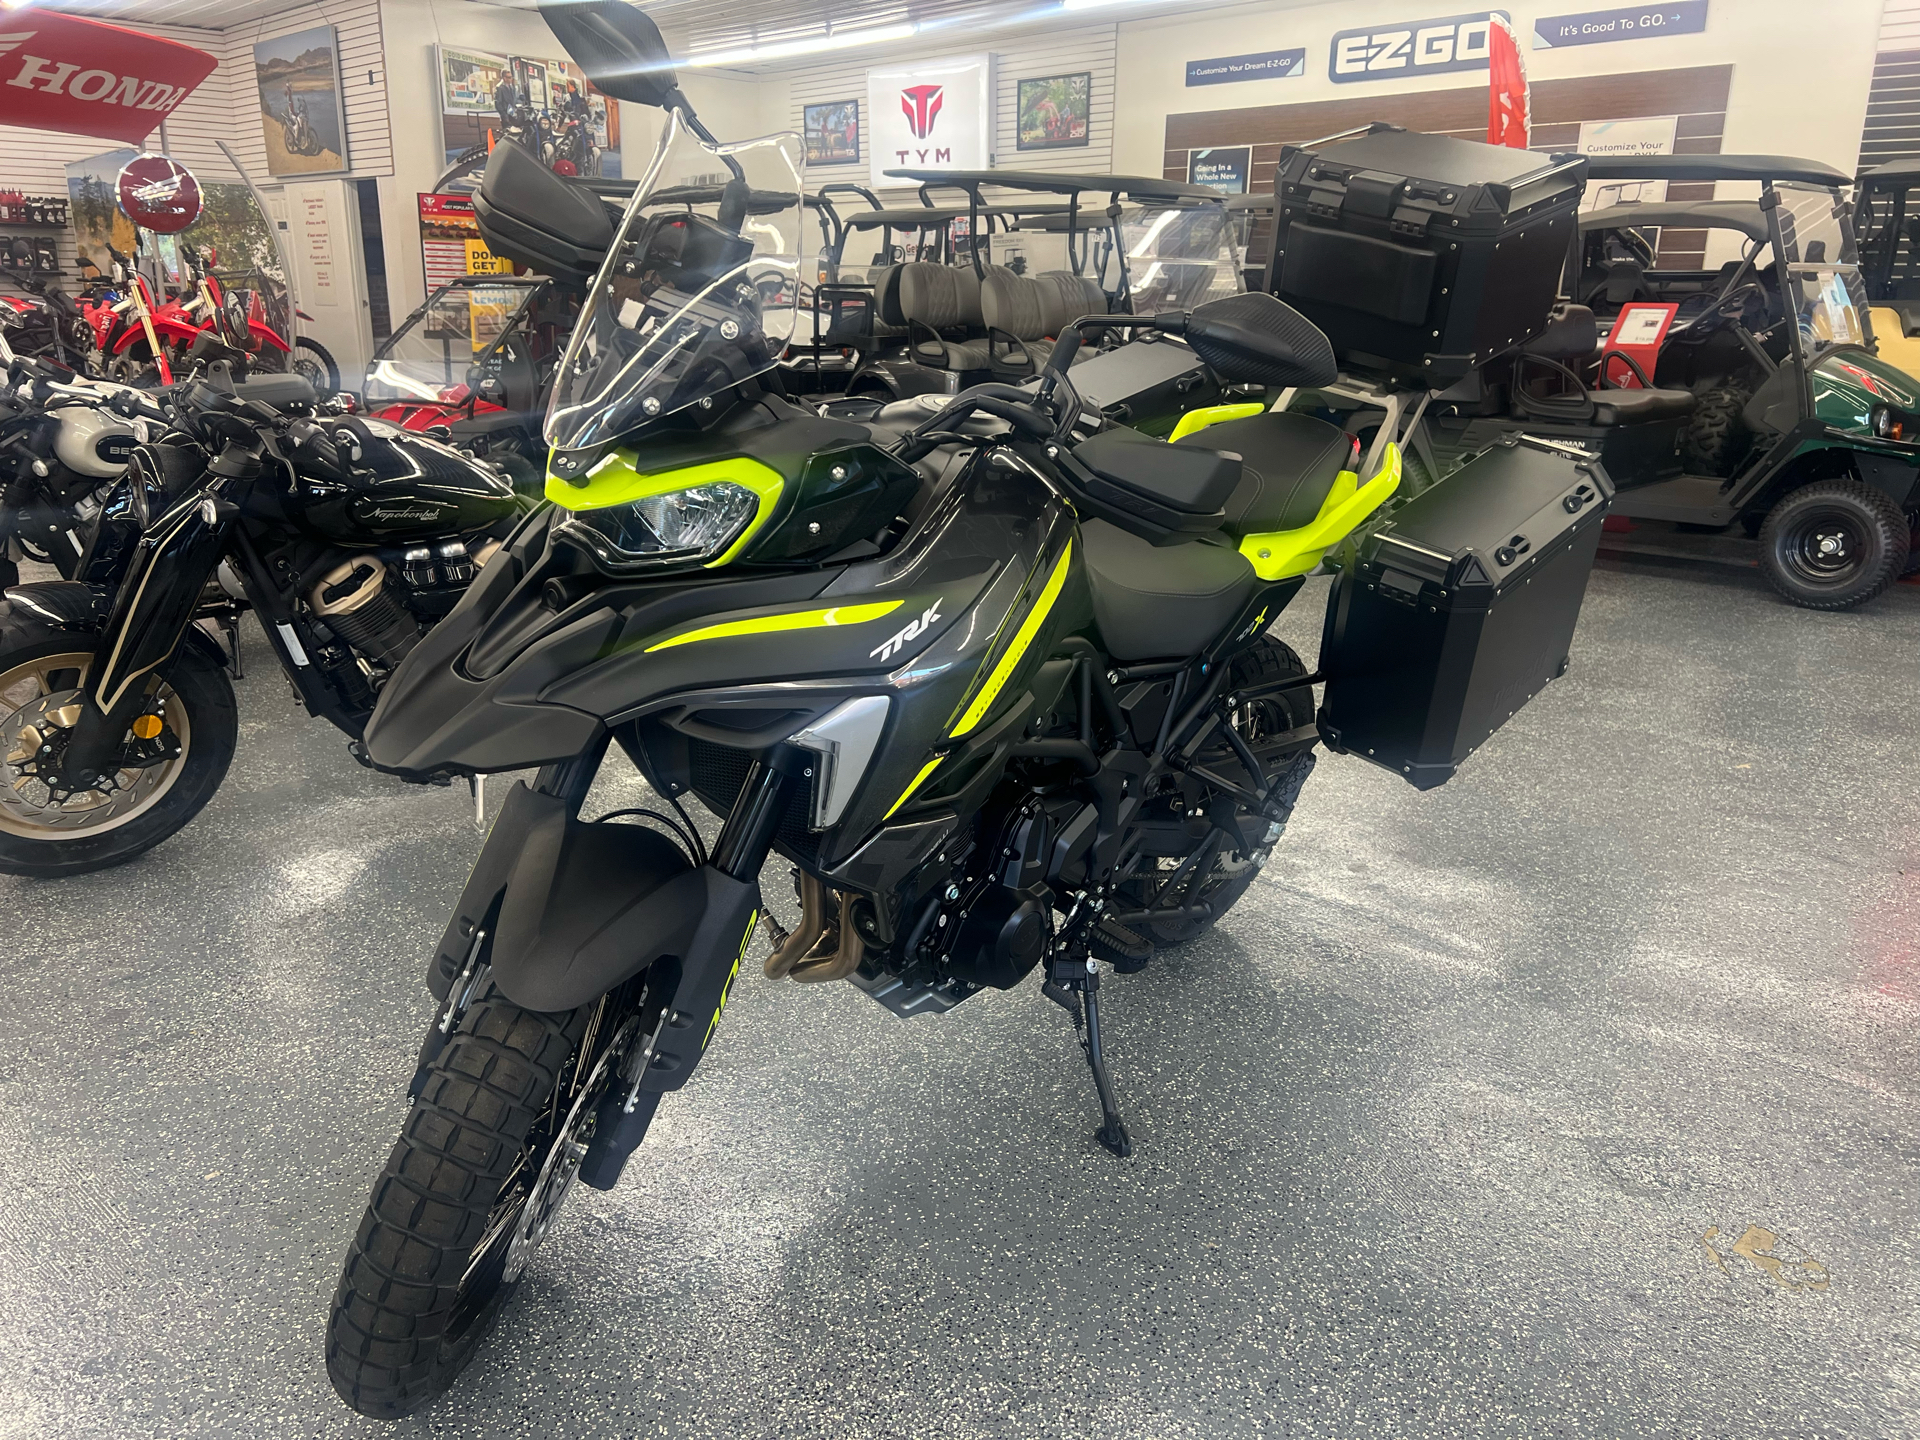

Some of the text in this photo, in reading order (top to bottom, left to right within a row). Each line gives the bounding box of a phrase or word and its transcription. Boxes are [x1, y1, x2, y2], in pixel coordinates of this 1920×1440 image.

[1560, 13, 1666, 36] It's Good To GO.
[1196, 67, 1228, 76] Customize
[1244, 62, 1266, 71] Dream
[6, 54, 187, 112] HONDA
[1587, 142, 1664, 153] Customize Your
[896, 147, 950, 165] TYM
[1196, 164, 1217, 172] Going
[1218, 163, 1226, 171] In
[1196, 172, 1237, 181] Whole New
[473, 261, 497, 270] GET
[474, 296, 512, 304] LEMON
[869, 596, 943, 663] TRK
